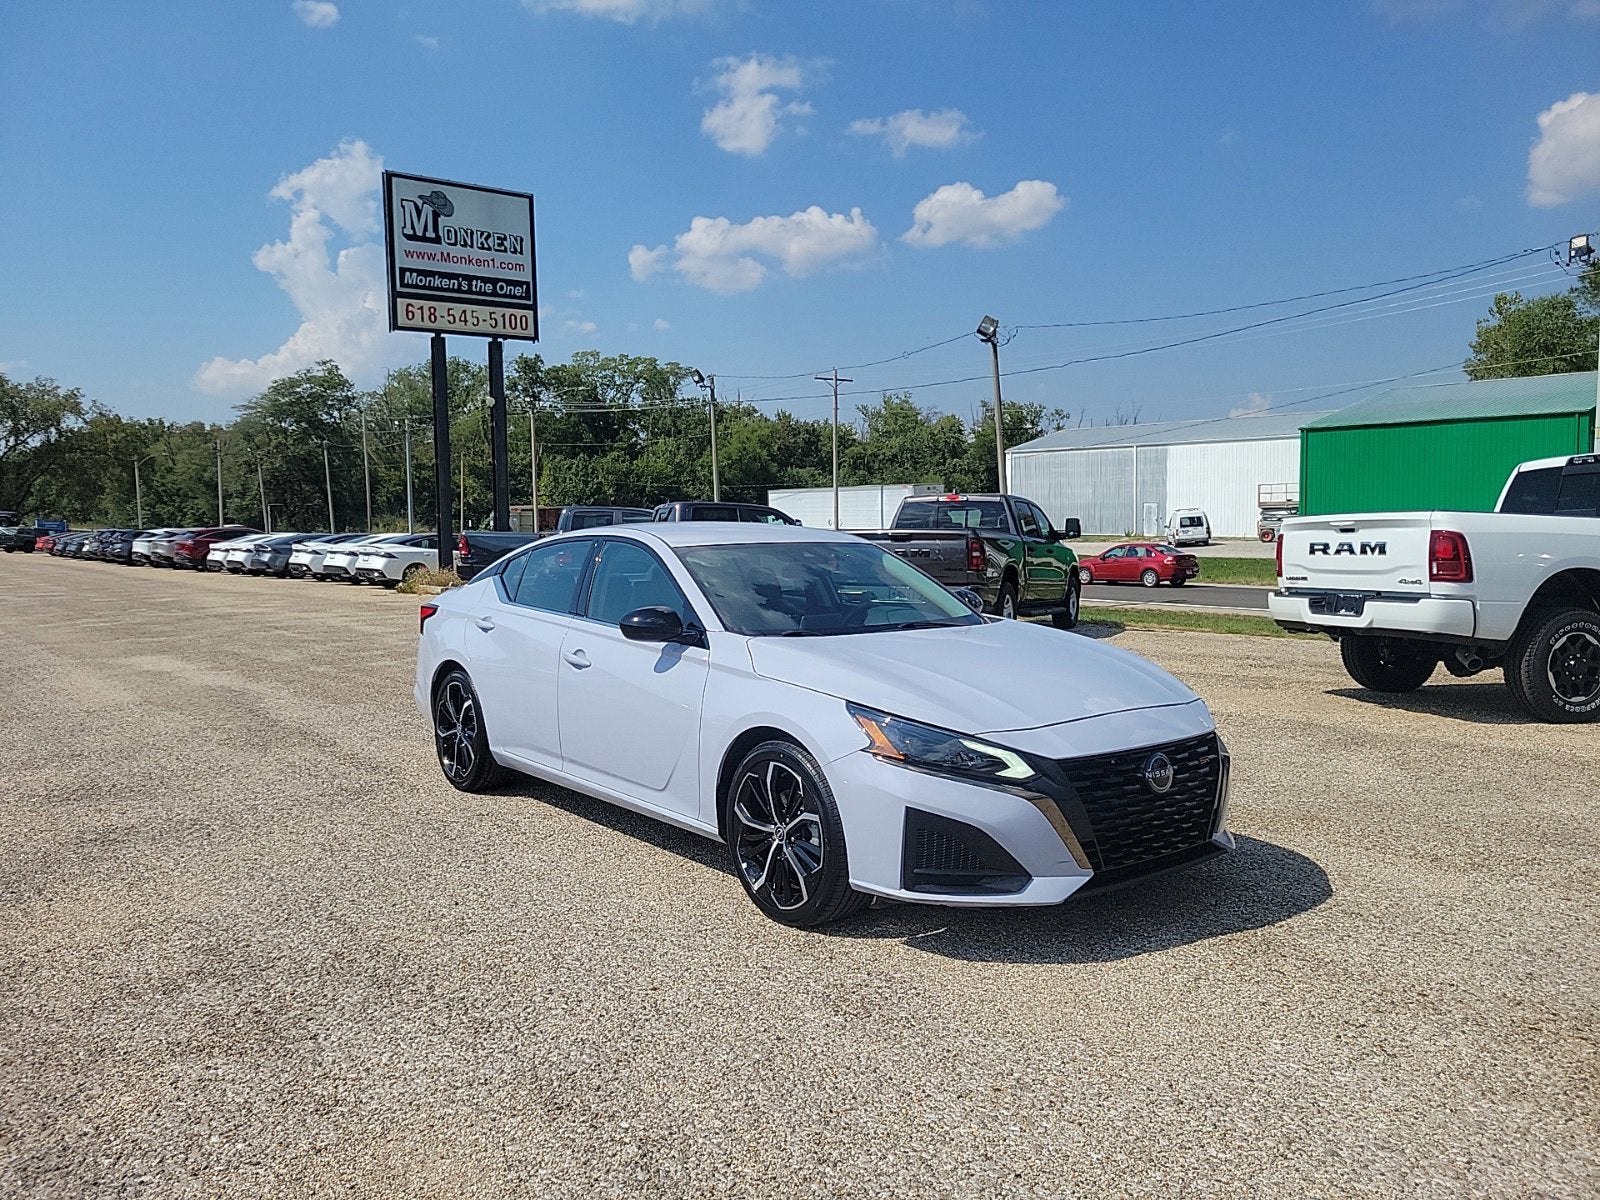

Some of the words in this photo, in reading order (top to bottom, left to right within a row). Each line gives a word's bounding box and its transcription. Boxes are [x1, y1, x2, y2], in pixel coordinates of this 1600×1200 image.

[401, 198, 524, 255] MONKEN
[404, 249, 525, 273] www.Monken1.com
[404, 271, 469, 291] Monken's
[472, 279, 493, 293] the
[496, 282, 527, 297] One!
[405, 303, 529, 331] 618-545-5100
[1309, 541, 1388, 556] RAM
